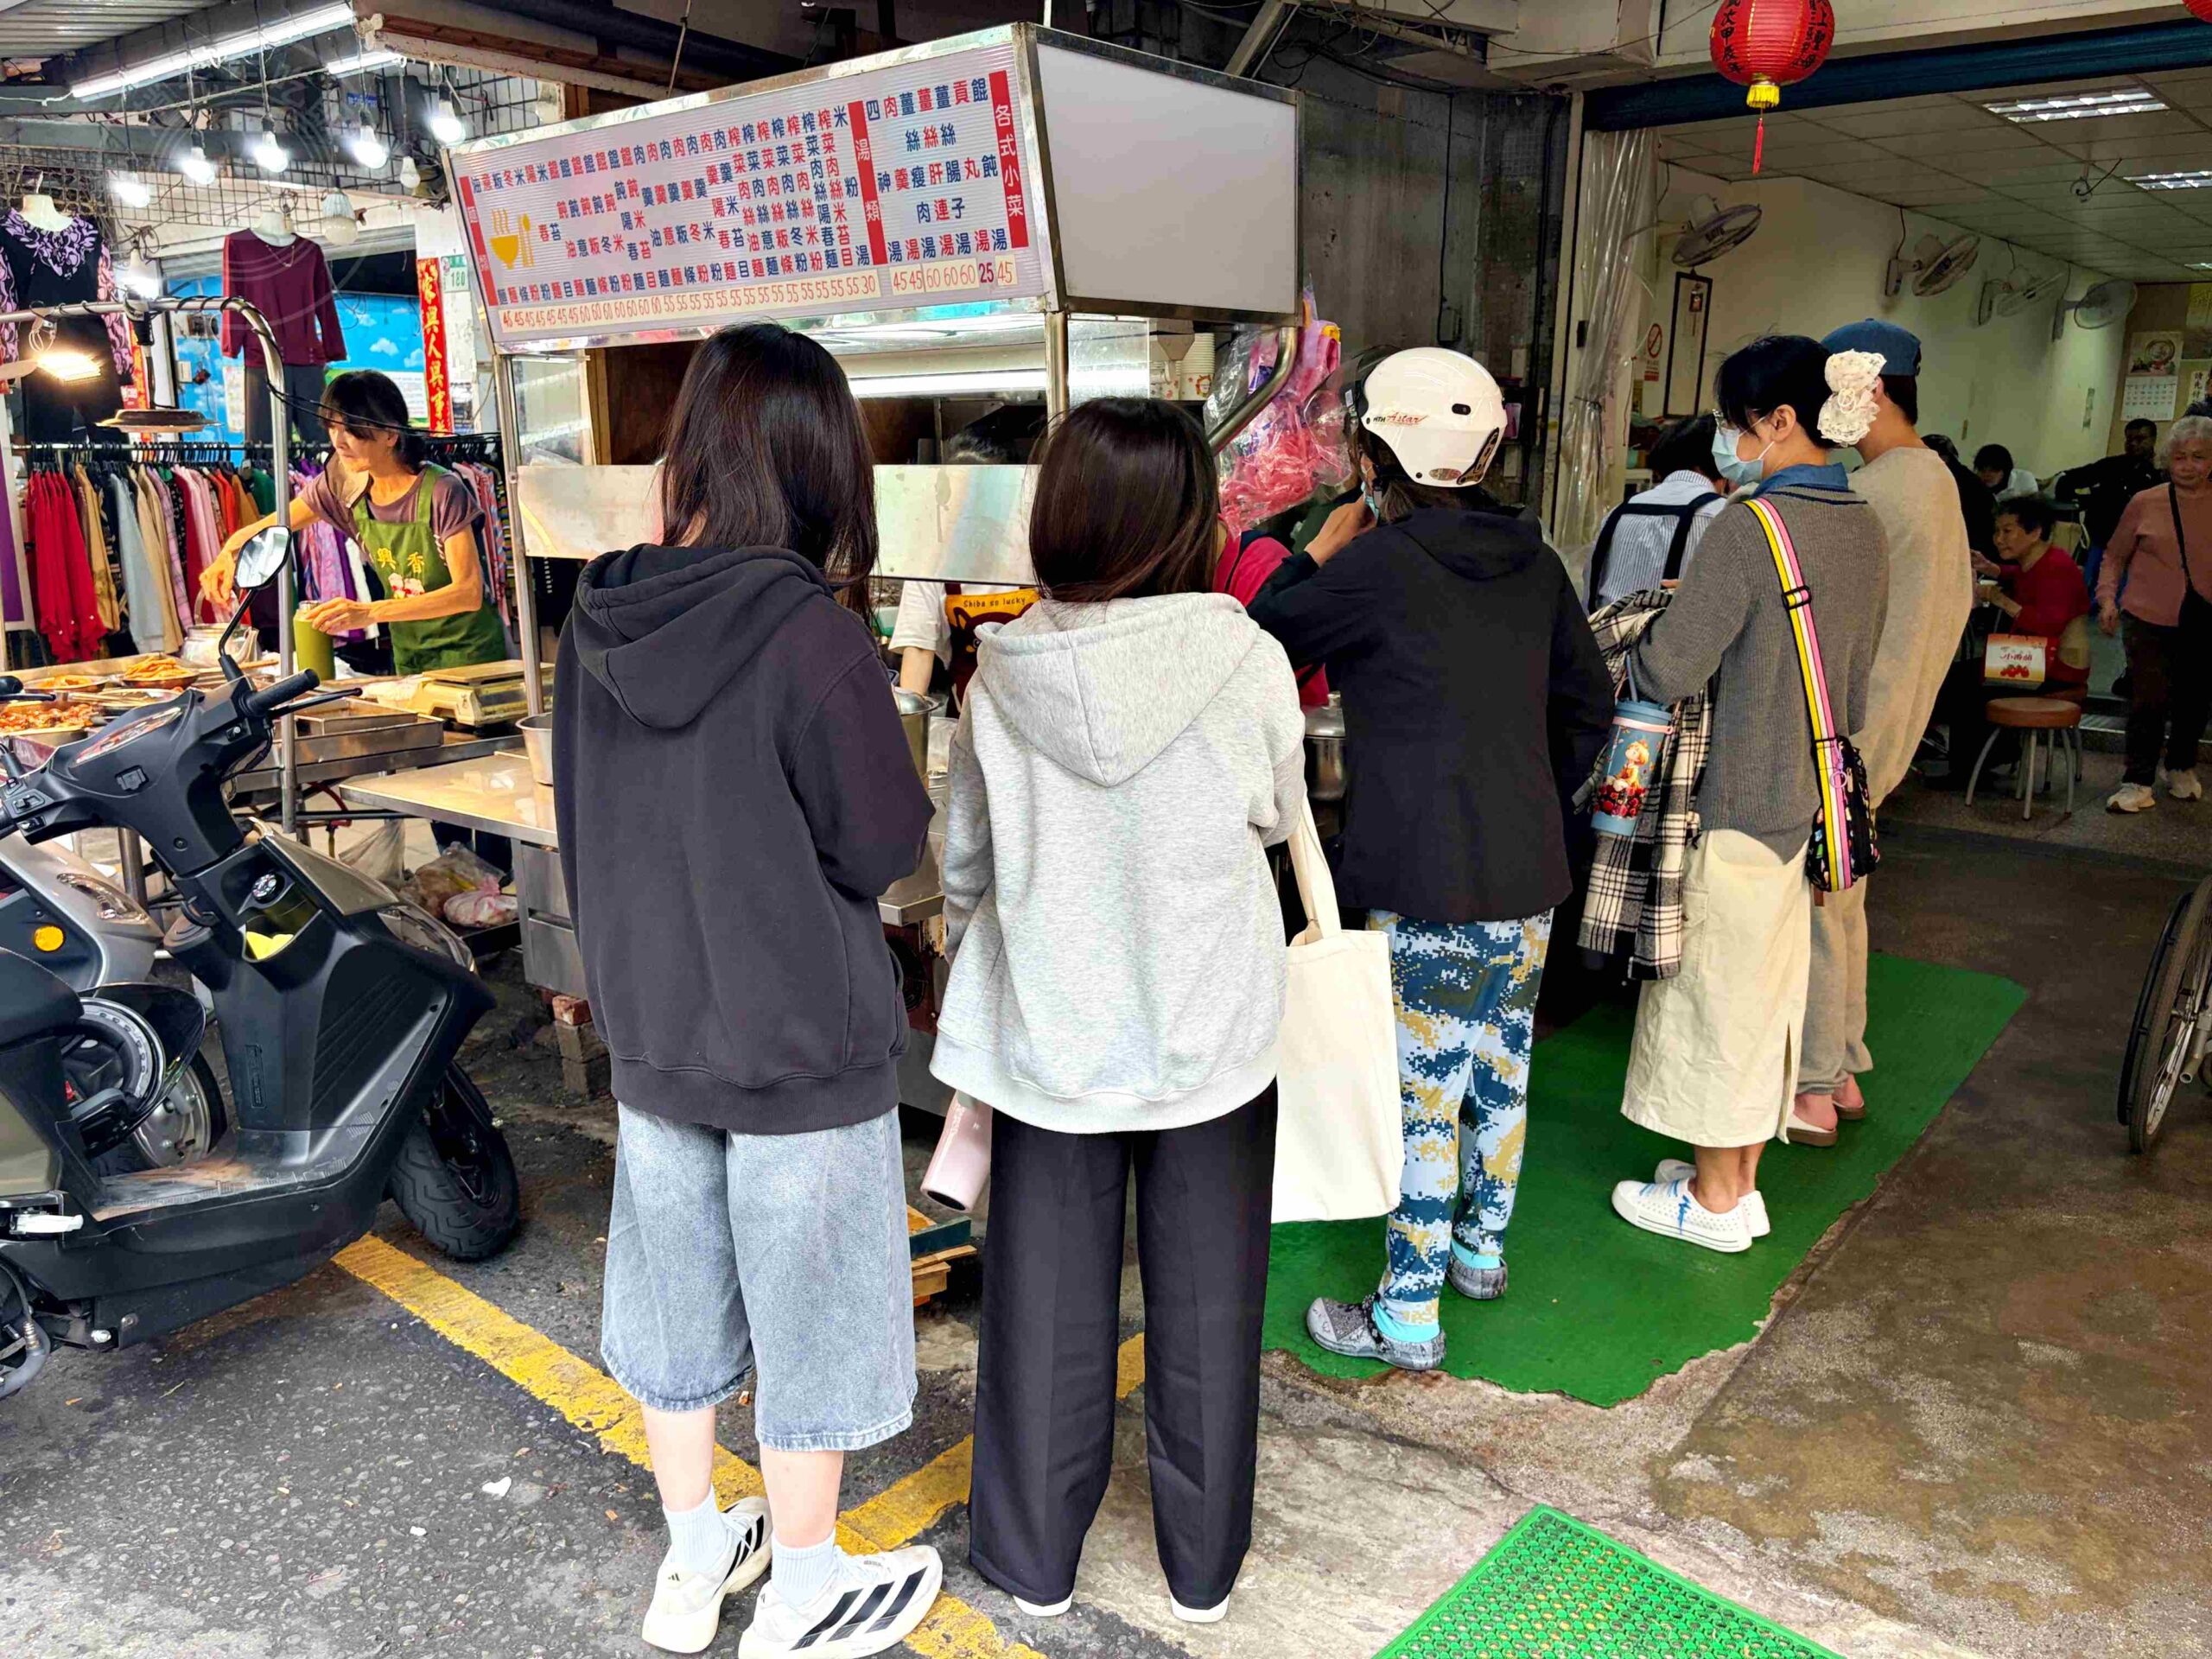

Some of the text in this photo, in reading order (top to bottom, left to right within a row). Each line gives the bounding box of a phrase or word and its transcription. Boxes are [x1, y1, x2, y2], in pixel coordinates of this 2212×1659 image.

[855, 138, 880, 221] 湯類
[995, 104, 1023, 218] 各式小菜
[451, 270, 466, 287] 180
[893, 261, 1014, 290] 45 45 60 60 60 25 45
[502, 275, 875, 327] 45 45 45 45 45 45 45 60 60 60 60 60 60 60 55 55 55 55 55 55 55 55 55 55 55 55 55 55 30
[963, 599, 986, 607] Shiba
[1003, 596, 1027, 606] lucky
